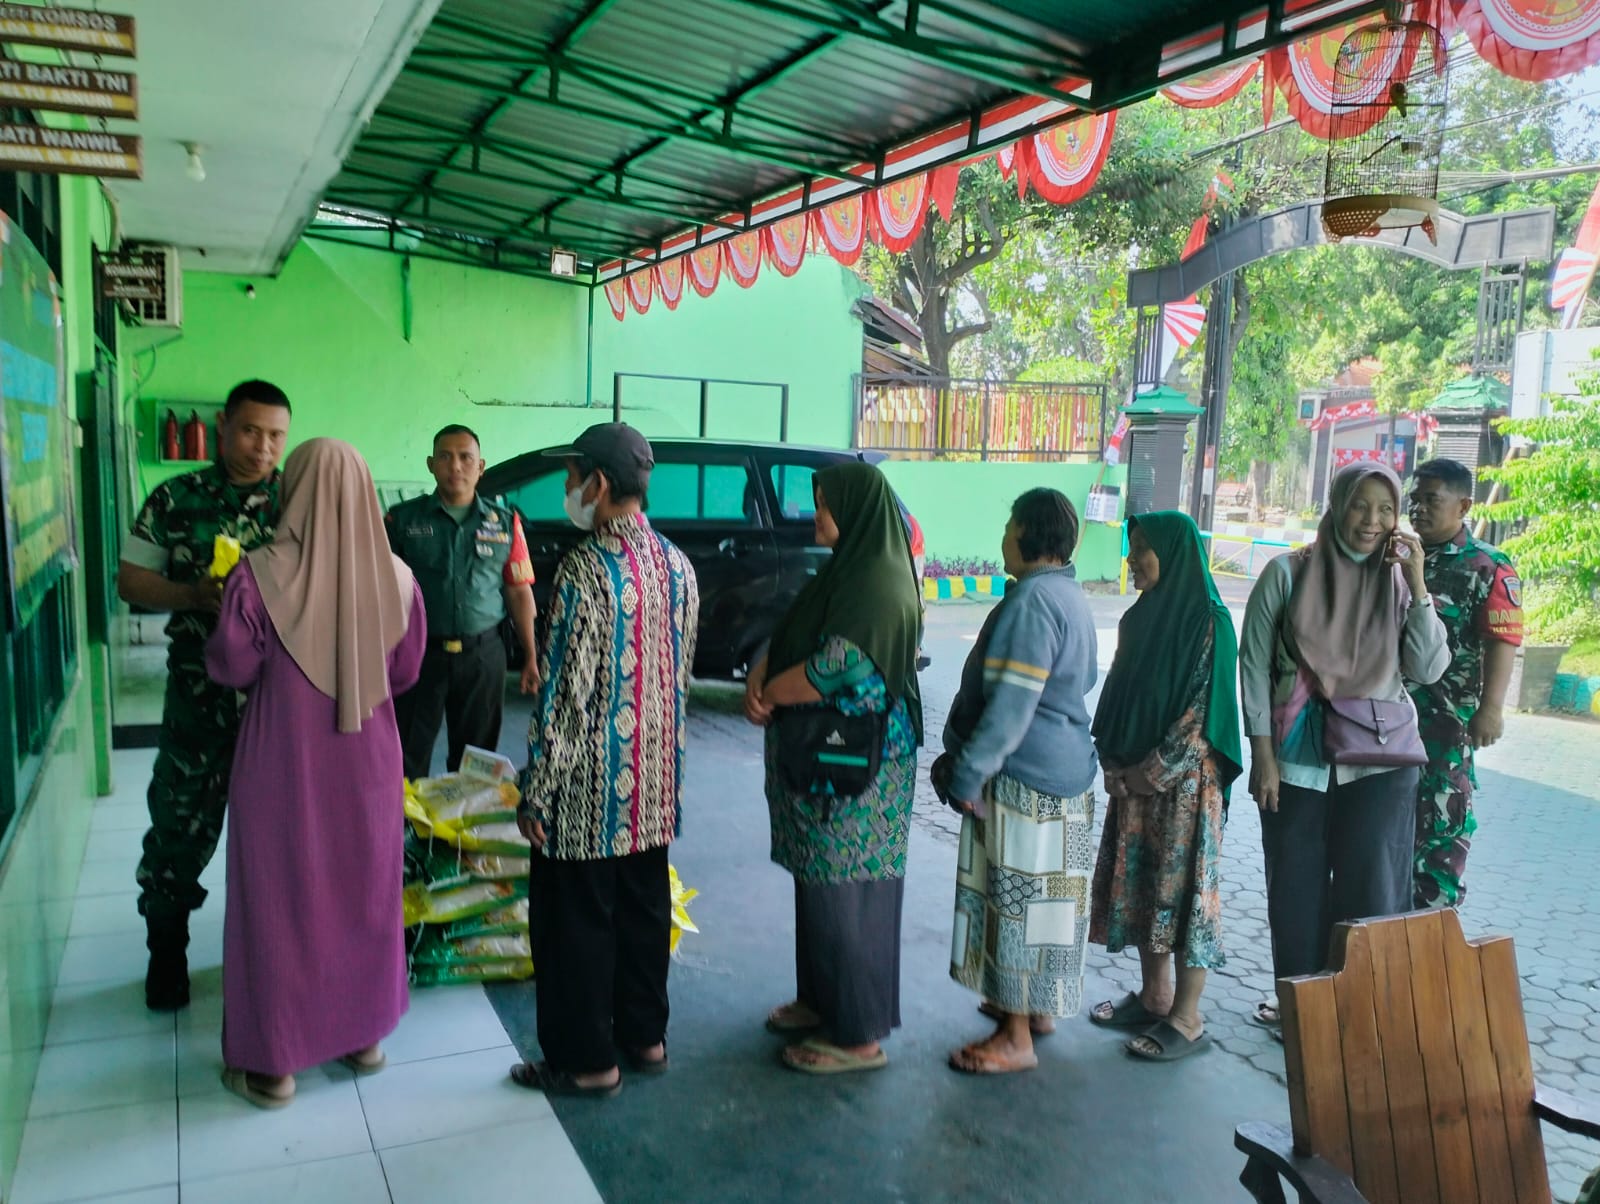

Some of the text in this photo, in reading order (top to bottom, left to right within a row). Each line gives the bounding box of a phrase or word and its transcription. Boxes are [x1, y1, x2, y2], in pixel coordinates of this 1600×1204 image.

[31, 8, 117, 32] KOMSOS
[26, 64, 90, 88] BAKTI
[94, 72, 129, 92] TNI
[40, 129, 124, 153] WANWIL
